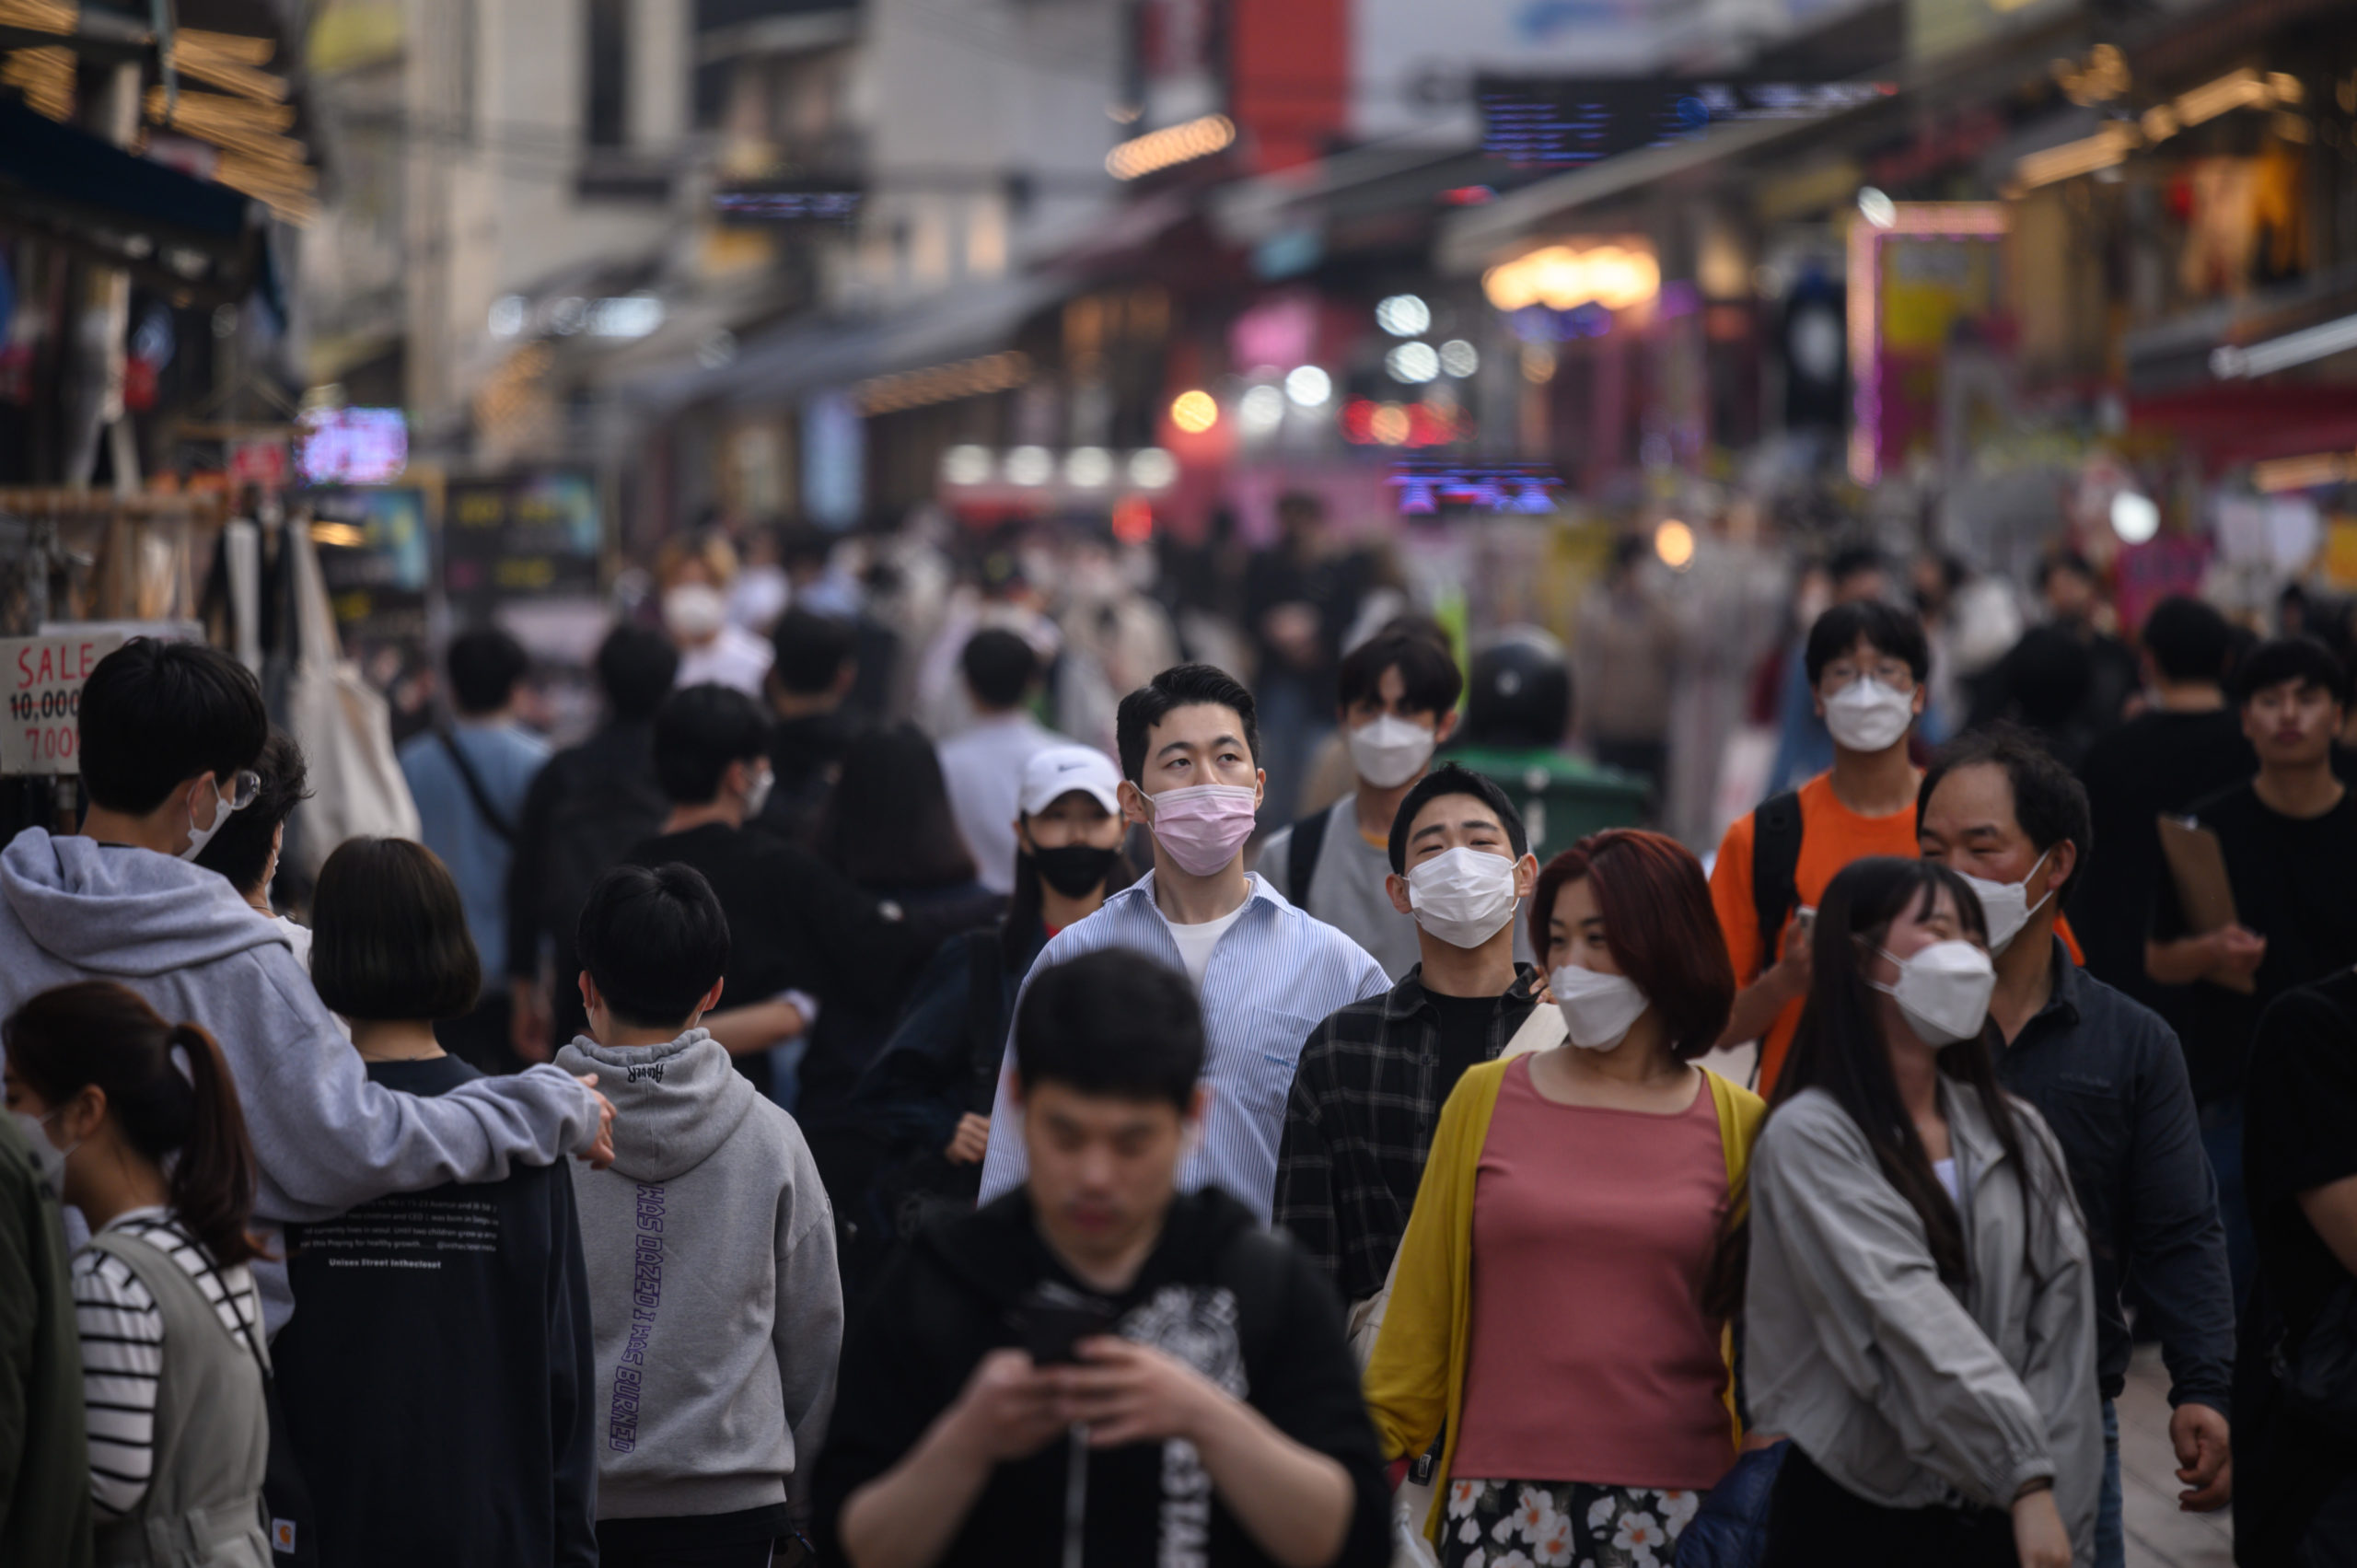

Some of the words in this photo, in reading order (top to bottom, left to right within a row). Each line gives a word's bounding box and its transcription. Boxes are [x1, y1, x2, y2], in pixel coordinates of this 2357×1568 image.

[17, 643, 94, 690] SALE
[10, 689, 80, 722] 10,000
[25, 726, 80, 761] 700
[636, 1184, 666, 1233] WAS
[329, 1259, 359, 1267] Unisex
[361, 1259, 389, 1267] Street
[633, 1234, 664, 1310] DAZED
[633, 1308, 656, 1322] I
[622, 1324, 652, 1365] WAS
[610, 1365, 642, 1454] BURNED
